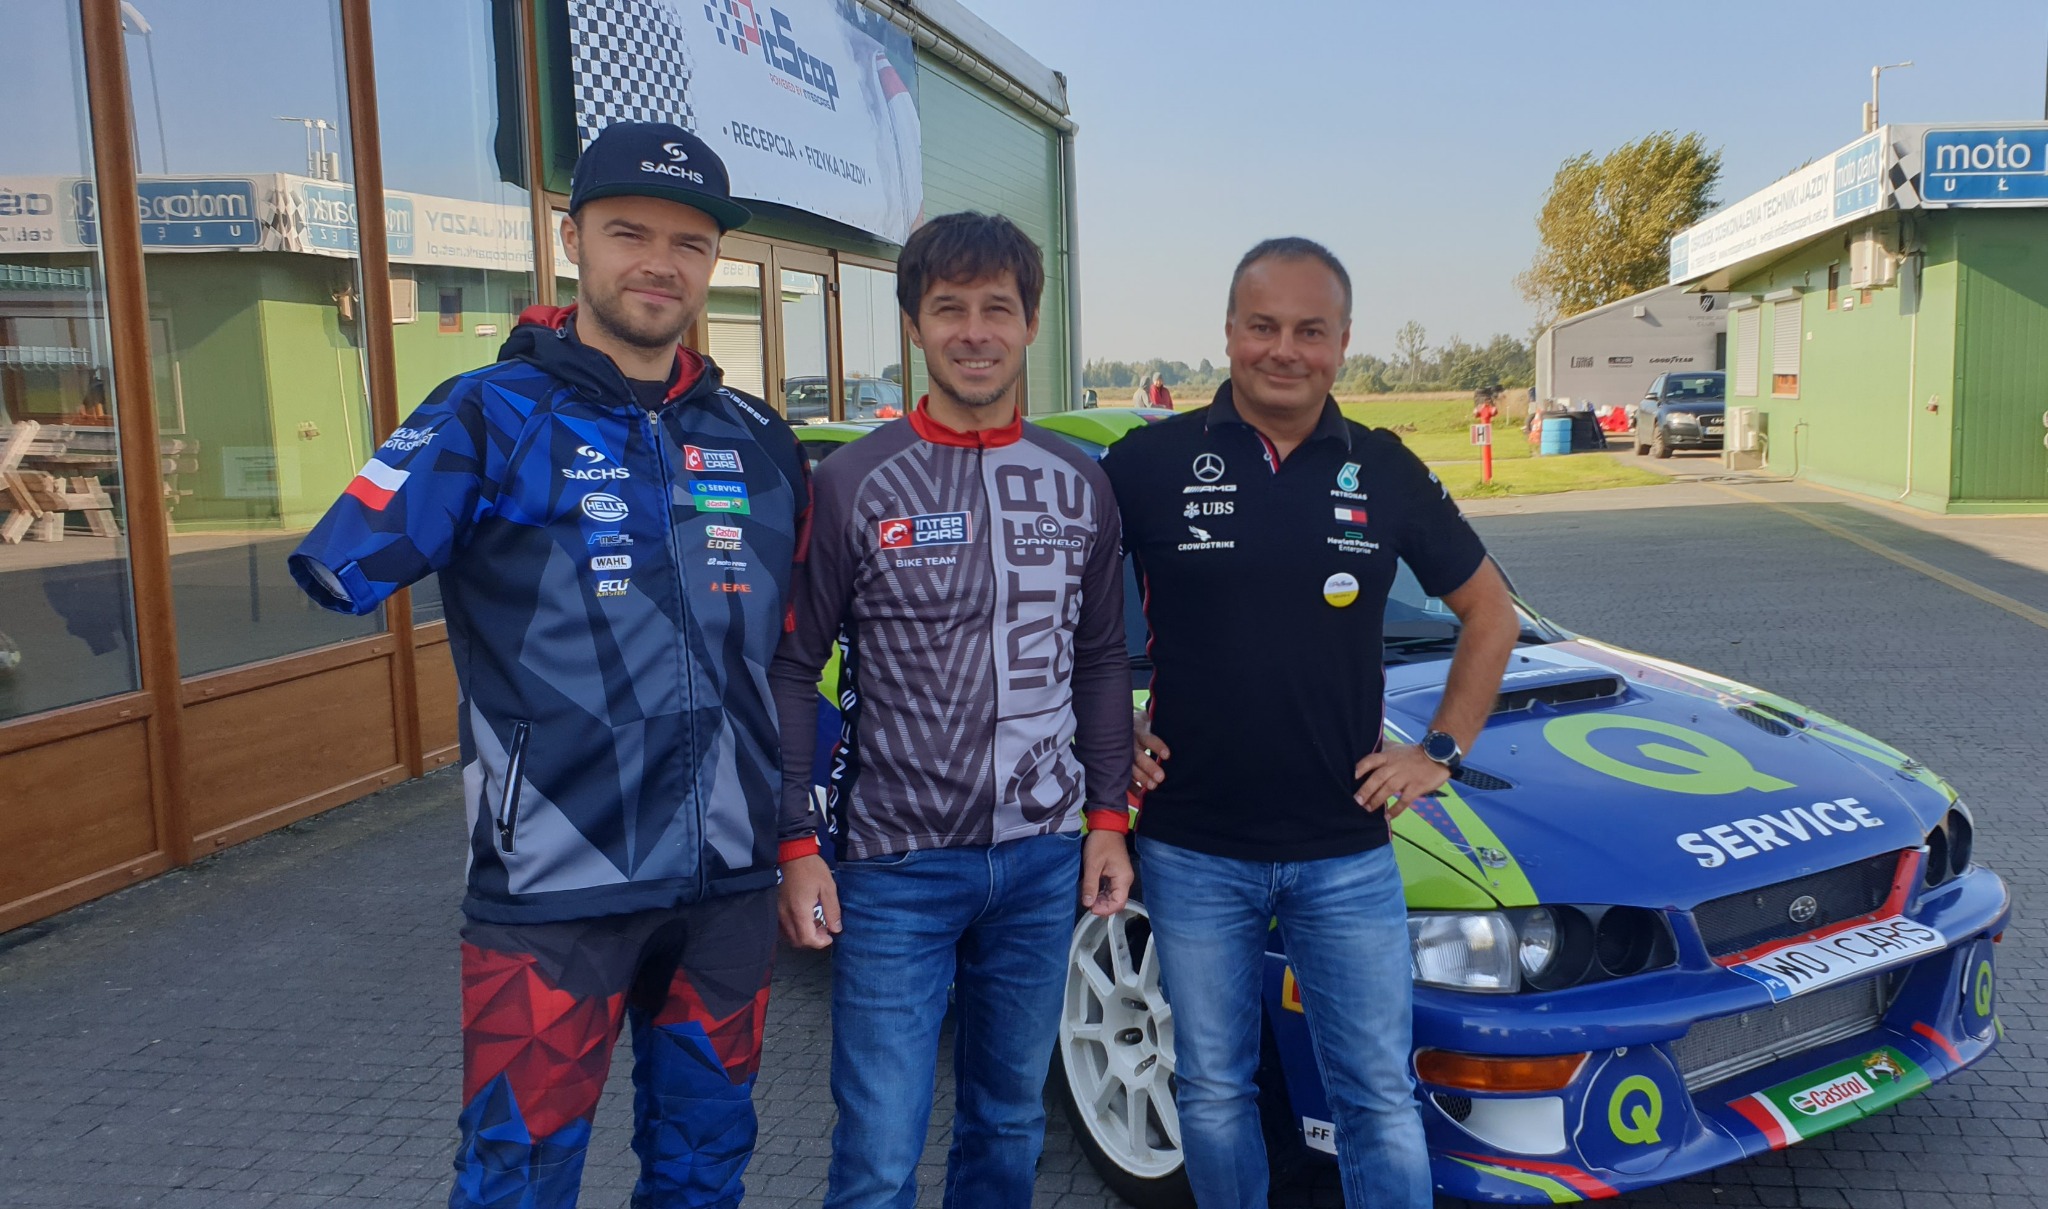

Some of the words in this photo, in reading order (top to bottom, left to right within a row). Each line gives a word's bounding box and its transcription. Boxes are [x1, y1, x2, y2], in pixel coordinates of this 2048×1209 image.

[731, 121, 798, 161] RECEPCJA
[804, 145, 841, 175] FIZYKA
[838, 158, 868, 187] JAZDY
[1936, 136, 2031, 170] moto
[1857, 144, 1878, 184] park
[640, 161, 704, 185] SACHS
[1800, 170, 1830, 205] JAZDY
[1649, 356, 1694, 364] GOODYEAR
[703, 452, 735, 461] INTER
[705, 460, 737, 469] CARS
[561, 467, 631, 480] SACHS
[708, 484, 743, 493] SERVICE
[1200, 485, 1237, 493] AMG
[1330, 490, 1368, 501] PETRONAS
[587, 500, 629, 514] HELLA
[1203, 502, 1235, 515] UBS
[916, 516, 963, 531] INTER
[715, 527, 740, 538] Castrol
[916, 527, 963, 542] CARS
[707, 539, 743, 550] EDGE
[1013, 538, 1082, 548] DANIELO
[1177, 541, 1235, 551] CROWDSTRIKE
[1338, 544, 1372, 554] Enterprise
[1355, 540, 1380, 550] Packard
[596, 557, 627, 567] WAHL
[895, 558, 923, 568] BIKE
[926, 556, 957, 566] TEAM
[599, 578, 631, 592] ECU
[1676, 797, 1885, 868] SERVICE
[1766, 978, 1785, 990] PL
[1809, 1076, 1869, 1108] Castrol
[1608, 1074, 1662, 1144] Q
